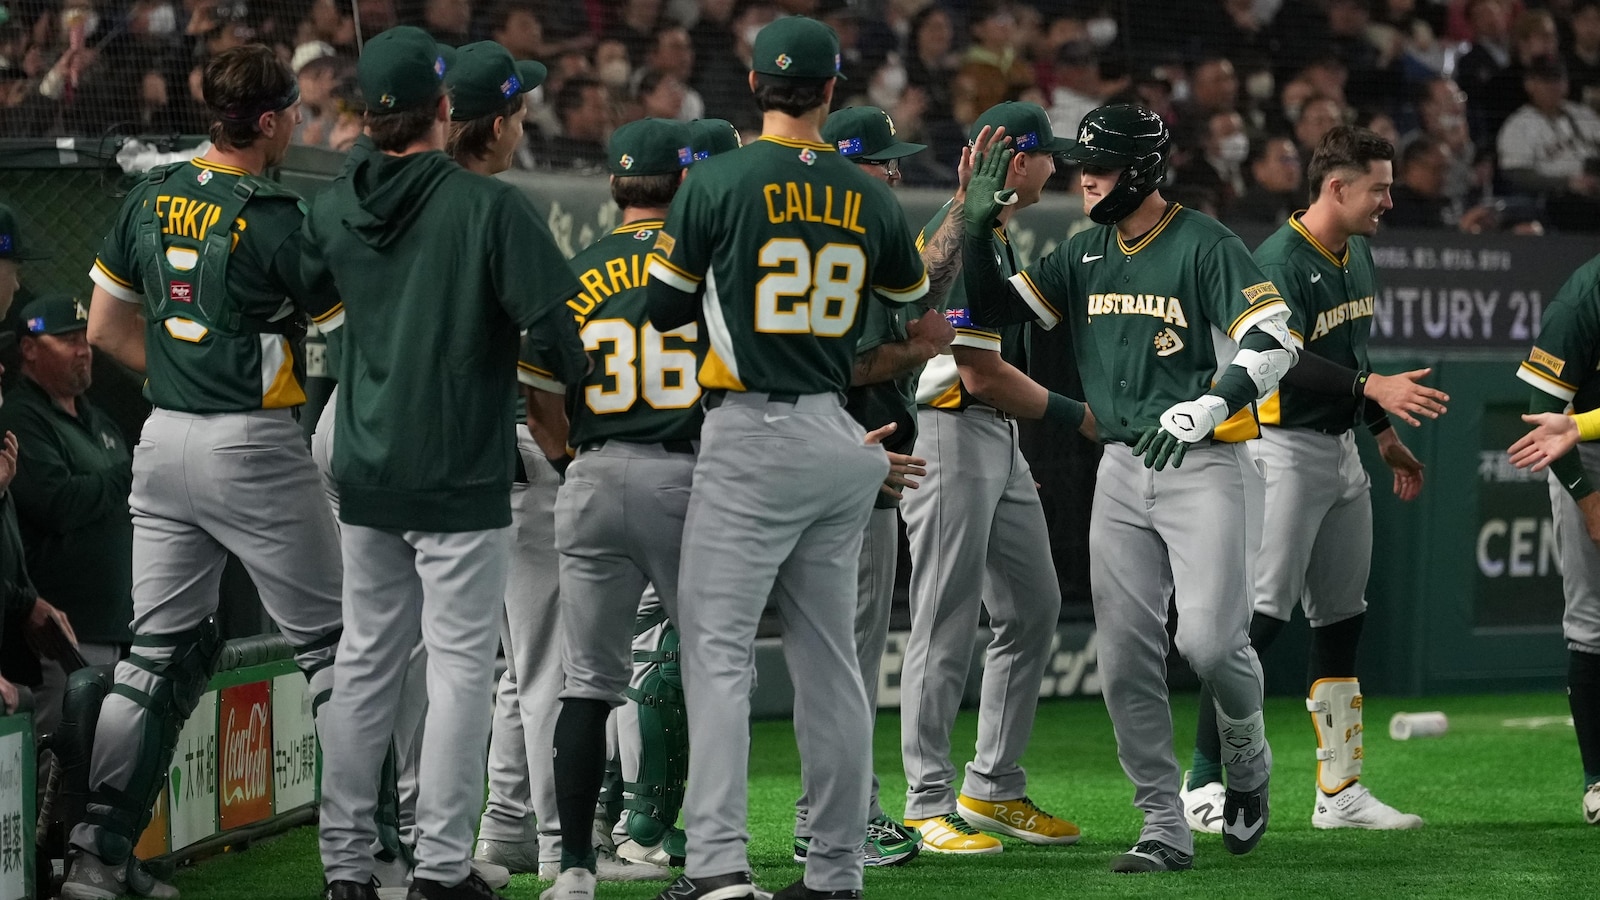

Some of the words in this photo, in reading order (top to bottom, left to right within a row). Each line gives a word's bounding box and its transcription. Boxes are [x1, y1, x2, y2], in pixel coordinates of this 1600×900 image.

[763, 181, 867, 234] CALLIL
[565, 252, 651, 330] URRI
[754, 237, 867, 338] 28
[1087, 292, 1189, 329] USTRALIA
[1508, 289, 1543, 341] 21
[579, 317, 702, 415] 36
[991, 804, 1037, 831] RG6
